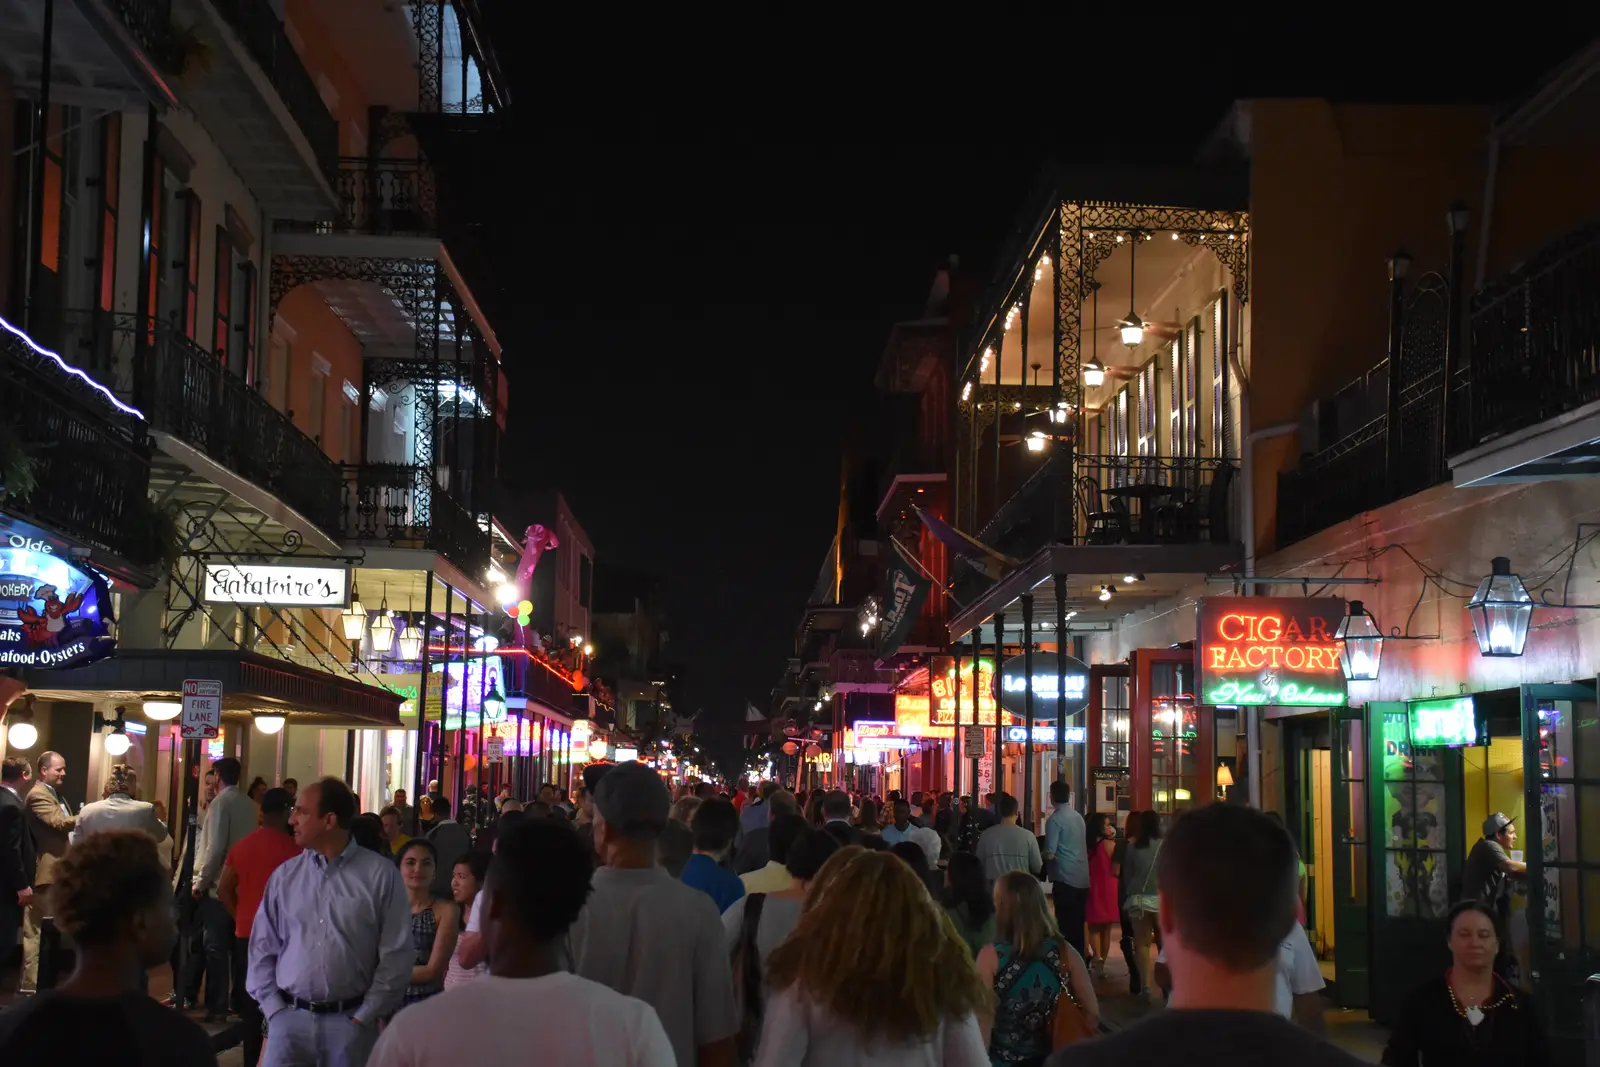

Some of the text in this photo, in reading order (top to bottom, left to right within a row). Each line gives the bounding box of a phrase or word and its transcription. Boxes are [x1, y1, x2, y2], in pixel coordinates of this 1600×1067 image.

[9, 535, 52, 553] Olde
[213, 569, 338, 598] Galatoire's
[1219, 614, 1331, 642] CIGAR
[0, 642, 85, 666] afood Oysters
[1210, 645, 1342, 670] FACTORY
[184, 682, 197, 694] NO
[1210, 682, 1268, 703] New
[191, 699, 212, 710] FIRE
[189, 712, 213, 722] LANE
[938, 712, 956, 722] PIZZ
